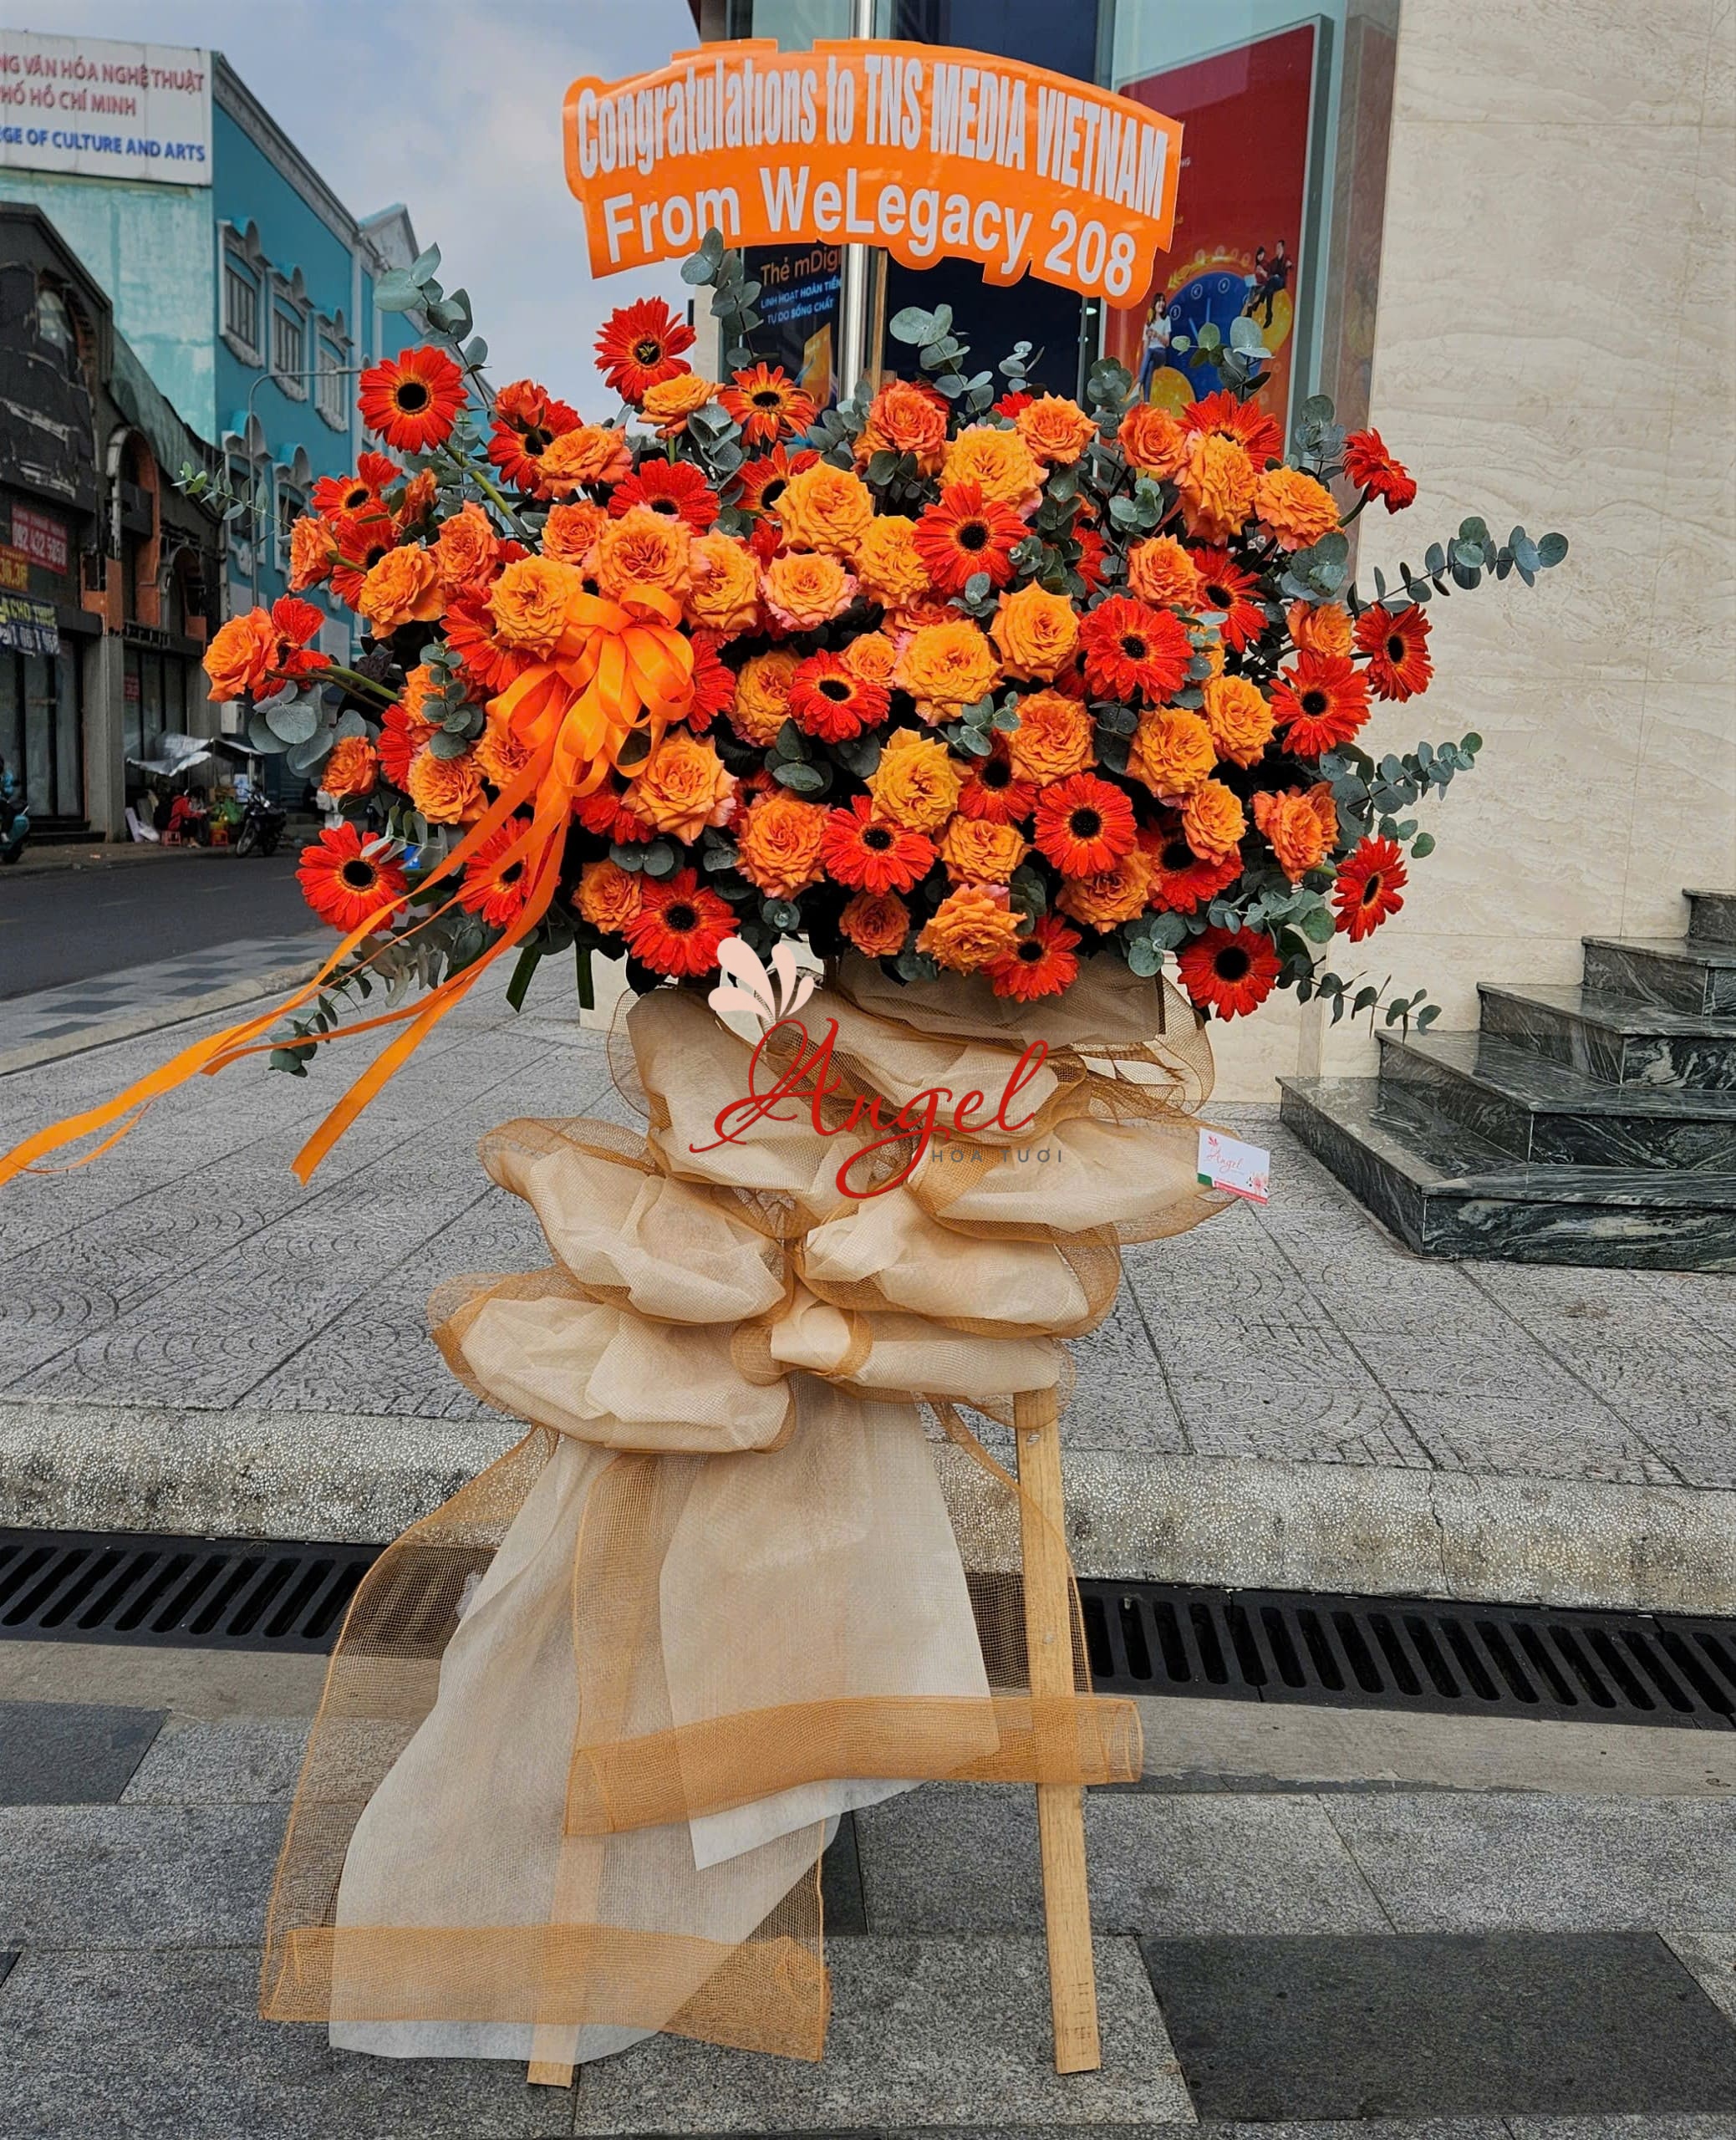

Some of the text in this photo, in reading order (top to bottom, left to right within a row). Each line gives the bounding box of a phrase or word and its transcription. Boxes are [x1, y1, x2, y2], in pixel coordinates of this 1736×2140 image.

[61, 55, 98, 82] HÓA
[151, 69, 205, 95] THUẬT
[59, 89, 87, 112] CHÍ
[91, 94, 136, 117] MINH
[0, 126, 206, 162] GE OF CULTURE AND ARTS
[578, 54, 1168, 221] Congratulations to TNS MEDIA VIETNAM
[603, 187, 741, 263] From
[759, 166, 1033, 275] WeLegacy
[1044, 209, 1136, 297] 208
[761, 256, 790, 286] Thẻ
